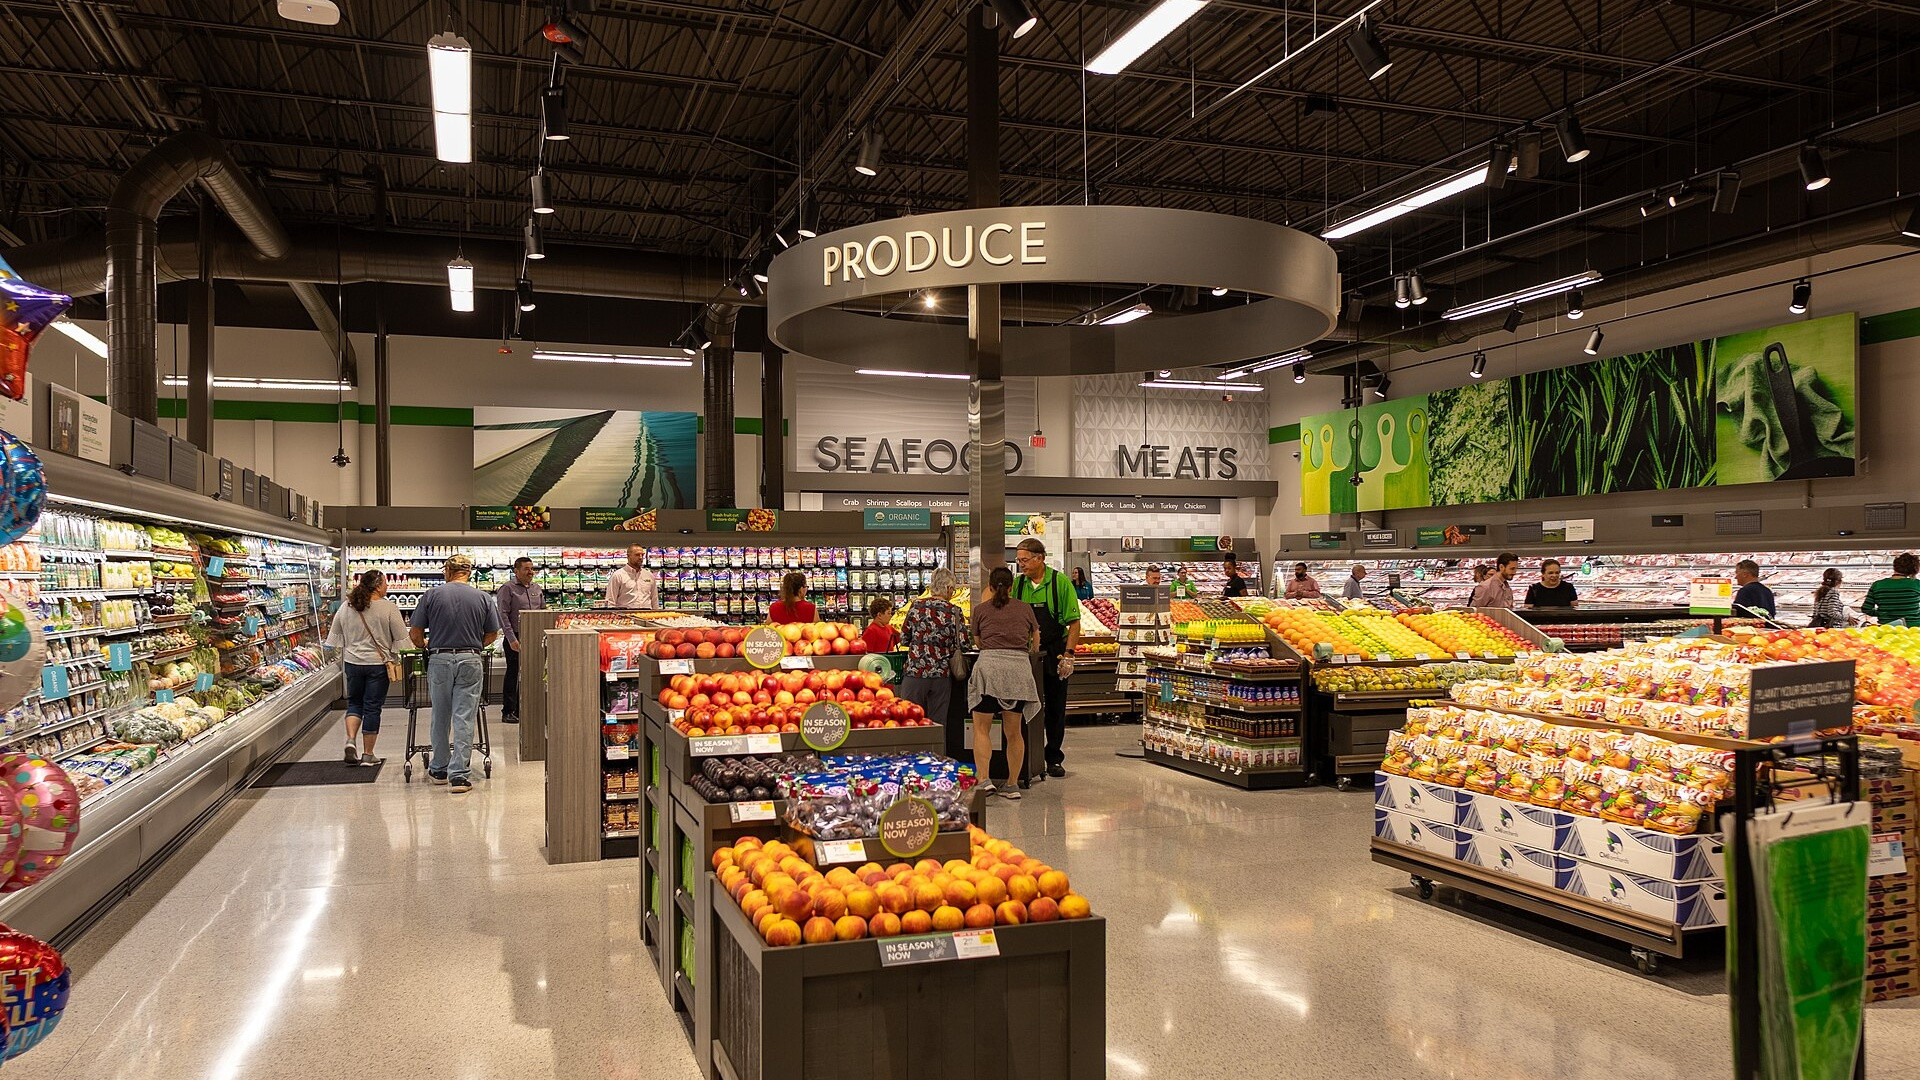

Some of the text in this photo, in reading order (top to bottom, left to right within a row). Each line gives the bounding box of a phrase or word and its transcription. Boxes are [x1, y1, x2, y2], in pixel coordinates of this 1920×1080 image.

[823, 222, 1047, 286] PRODUCE
[817, 436, 1023, 474] SEAFOD
[1118, 444, 1238, 479] MEATS
[866, 499, 890, 508] Shrimp
[896, 499, 922, 508] Scallops
[929, 499, 953, 507] Lobster
[1081, 501, 1096, 509] Beef
[1100, 501, 1114, 509] Pork
[1119, 501, 1136, 509] Lamb
[1160, 502, 1179, 511] Turkey
[1184, 502, 1206, 510] Chicken
[888, 513, 920, 521] ORGANIC
[803, 719, 847, 727] IN SEASON
[803, 727, 824, 735] NOW
[705, 740, 733, 748] SEASON
[883, 817, 934, 830] IN SEASON
[883, 829, 908, 839] NOW
[885, 941, 934, 953] IN SEASON
[887, 951, 911, 960] NOW
[0, 968, 42, 1002] ET
